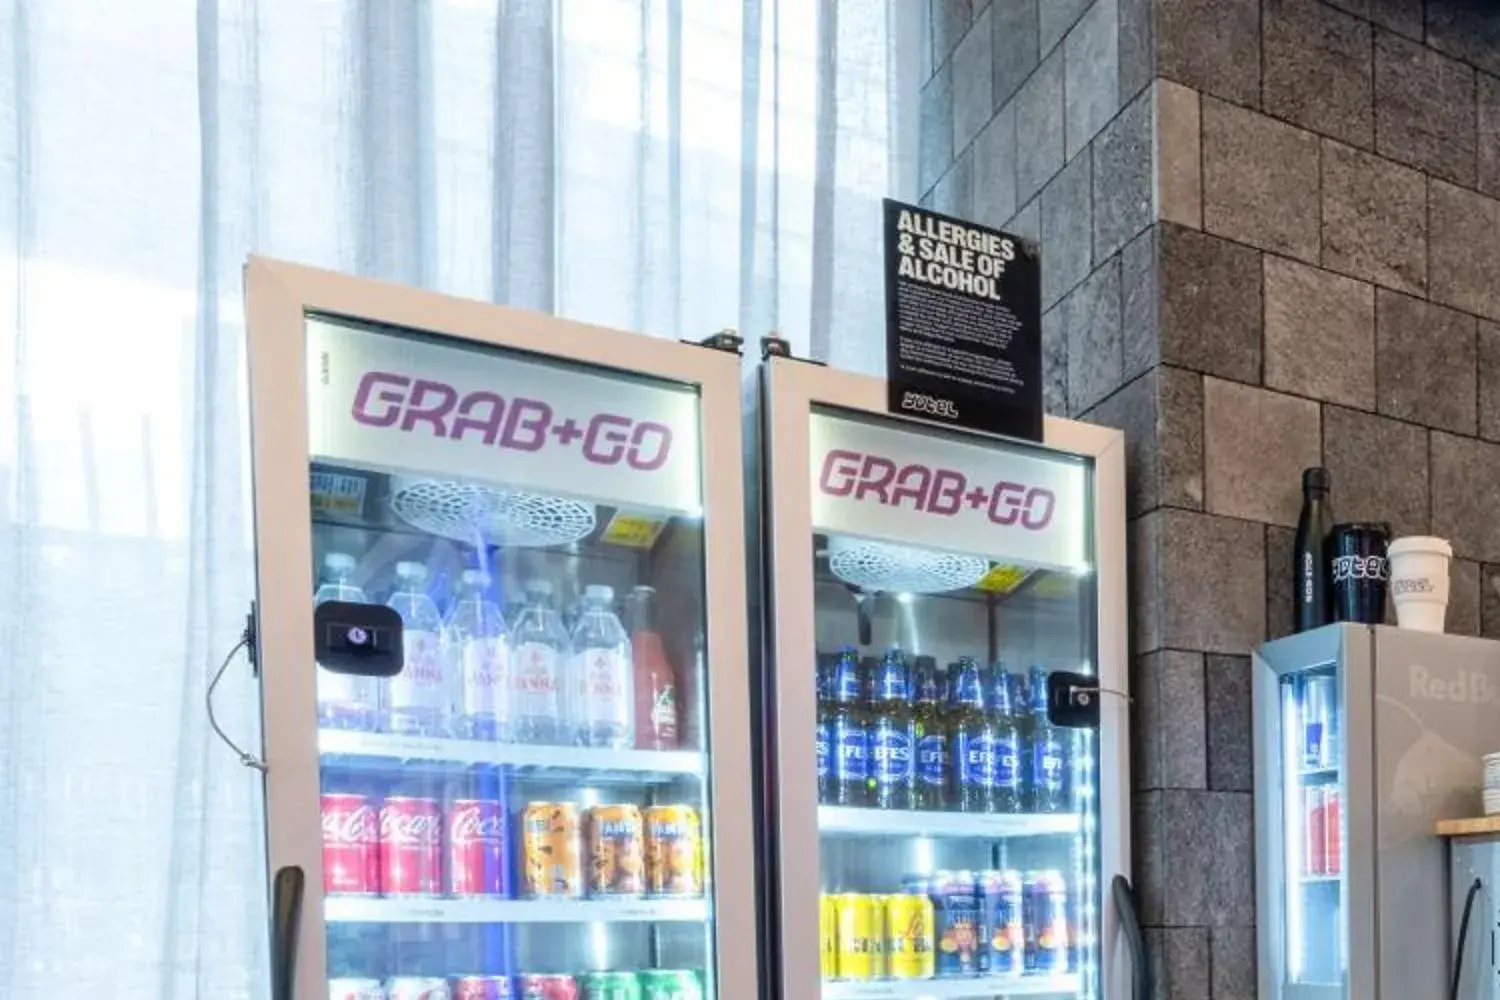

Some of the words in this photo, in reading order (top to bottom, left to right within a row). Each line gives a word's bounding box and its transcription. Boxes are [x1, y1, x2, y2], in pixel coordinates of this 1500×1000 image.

[897, 209, 1015, 260] ALLERGIES
[898, 232, 915, 256] &
[919, 238, 974, 272] SALE
[978, 255, 1005, 279] OF
[898, 255, 1001, 300] ALCOHOL
[351, 370, 673, 471] GRAB+GO
[819, 449, 1056, 531] GRAB+GO
